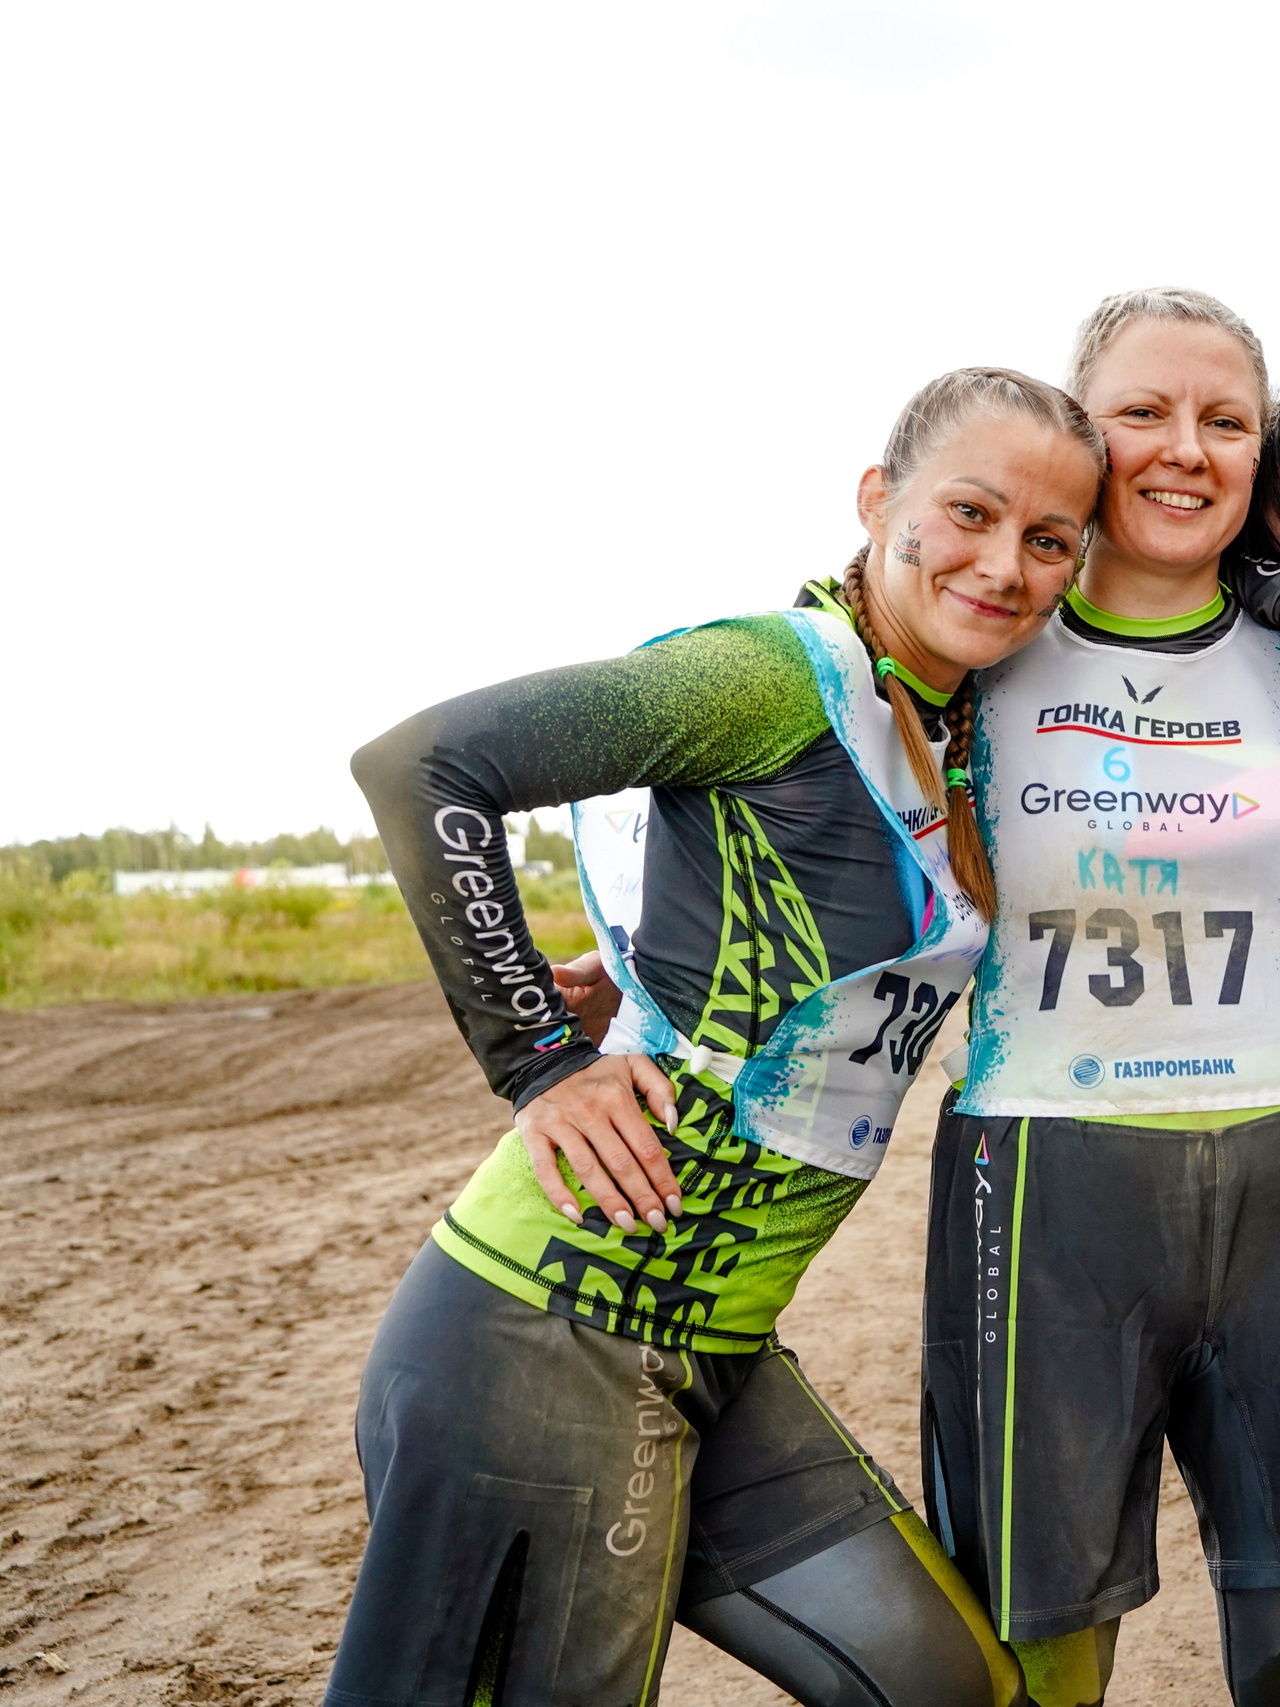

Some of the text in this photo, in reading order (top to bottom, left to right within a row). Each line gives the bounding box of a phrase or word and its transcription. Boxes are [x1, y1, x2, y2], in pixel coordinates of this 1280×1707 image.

[1037, 703, 1242, 740] ГОНКА ГЕРОЕВ
[1102, 746, 1132, 783] 6
[1020, 782, 1231, 824] Greenway
[1087, 818, 1184, 834] GLOBAL
[1075, 848, 1180, 897] КАТЯ
[433, 805, 559, 1032] Greenway
[1027, 908, 1254, 1012] 7317
[1113, 1057, 1236, 1079] ГАЗПРОМБАНК
[985, 1225, 1002, 1343] GLOBAL
